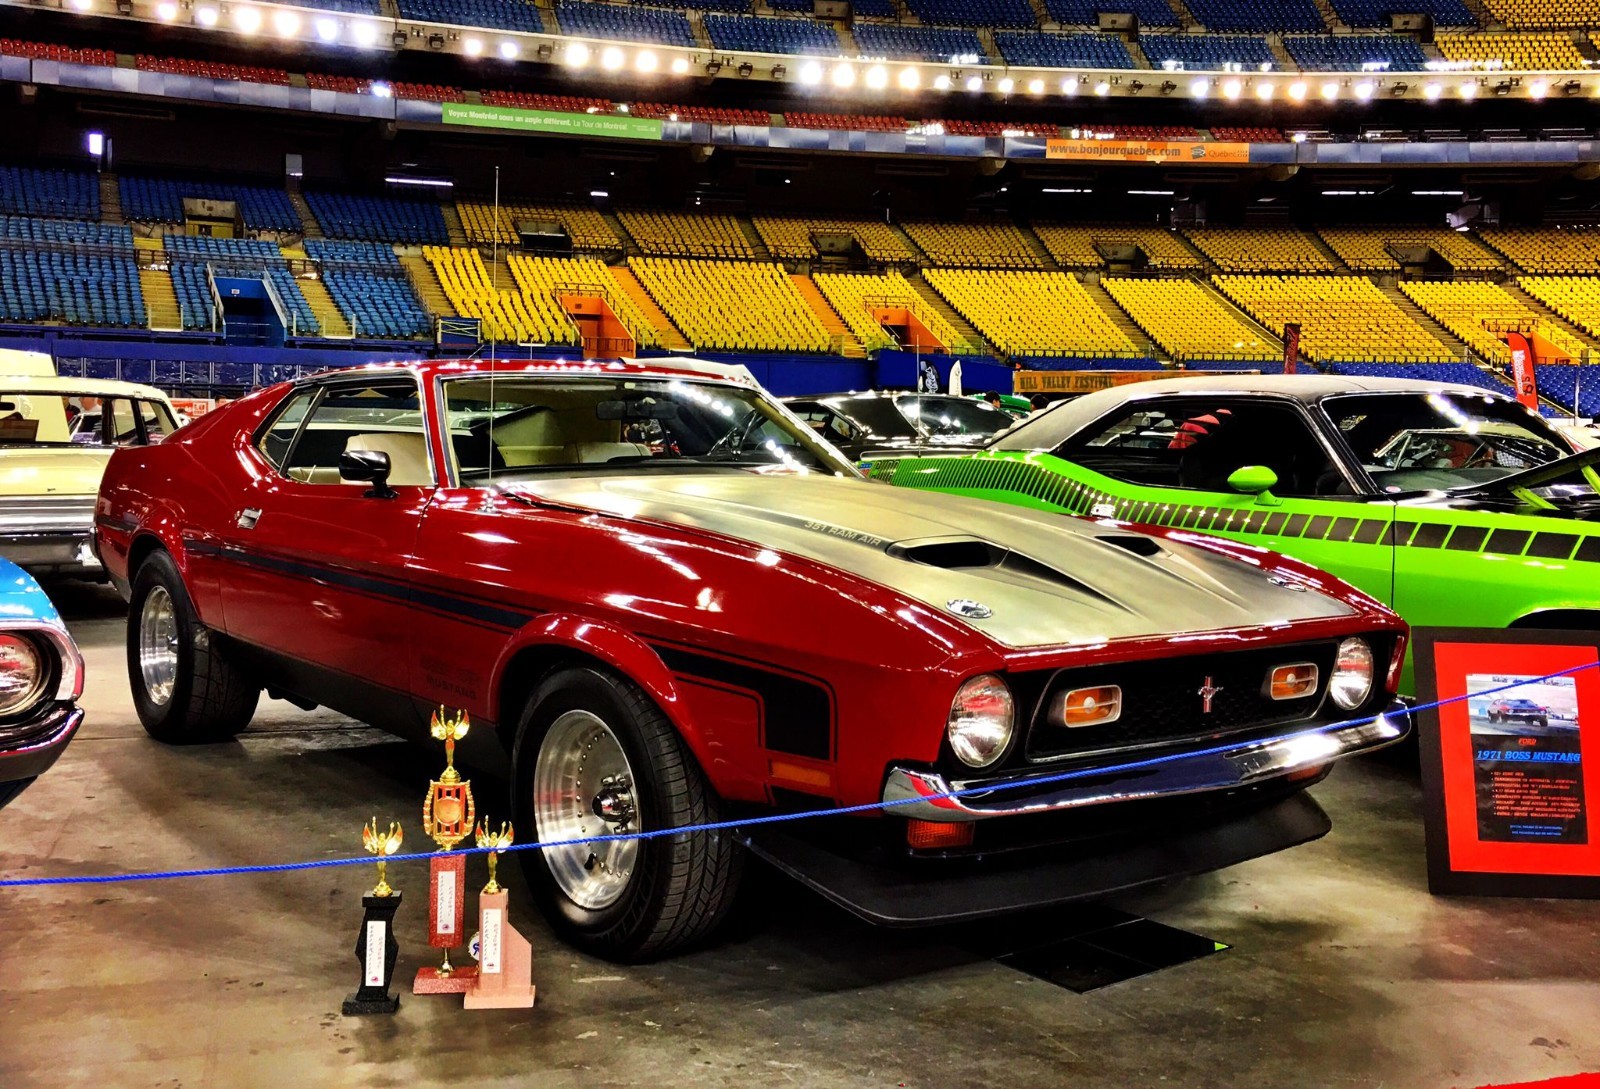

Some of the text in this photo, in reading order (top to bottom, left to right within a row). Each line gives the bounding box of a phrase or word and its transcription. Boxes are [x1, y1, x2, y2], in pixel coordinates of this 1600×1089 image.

[448, 109, 468, 118] Voyez
[525, 116, 542, 125] angle
[582, 120, 594, 128] Tour
[595, 121, 602, 129] de
[1049, 144, 1181, 157] www.bonjourquebec.com
[1020, 376, 1038, 389] HILL
[1042, 376, 1071, 389] VALLEY
[1074, 375, 1112, 389] FESTIVAL
[804, 521, 882, 546] 351 RAM AIR
[1477, 750, 1581, 762] 1971 BOSS MUSTANG
